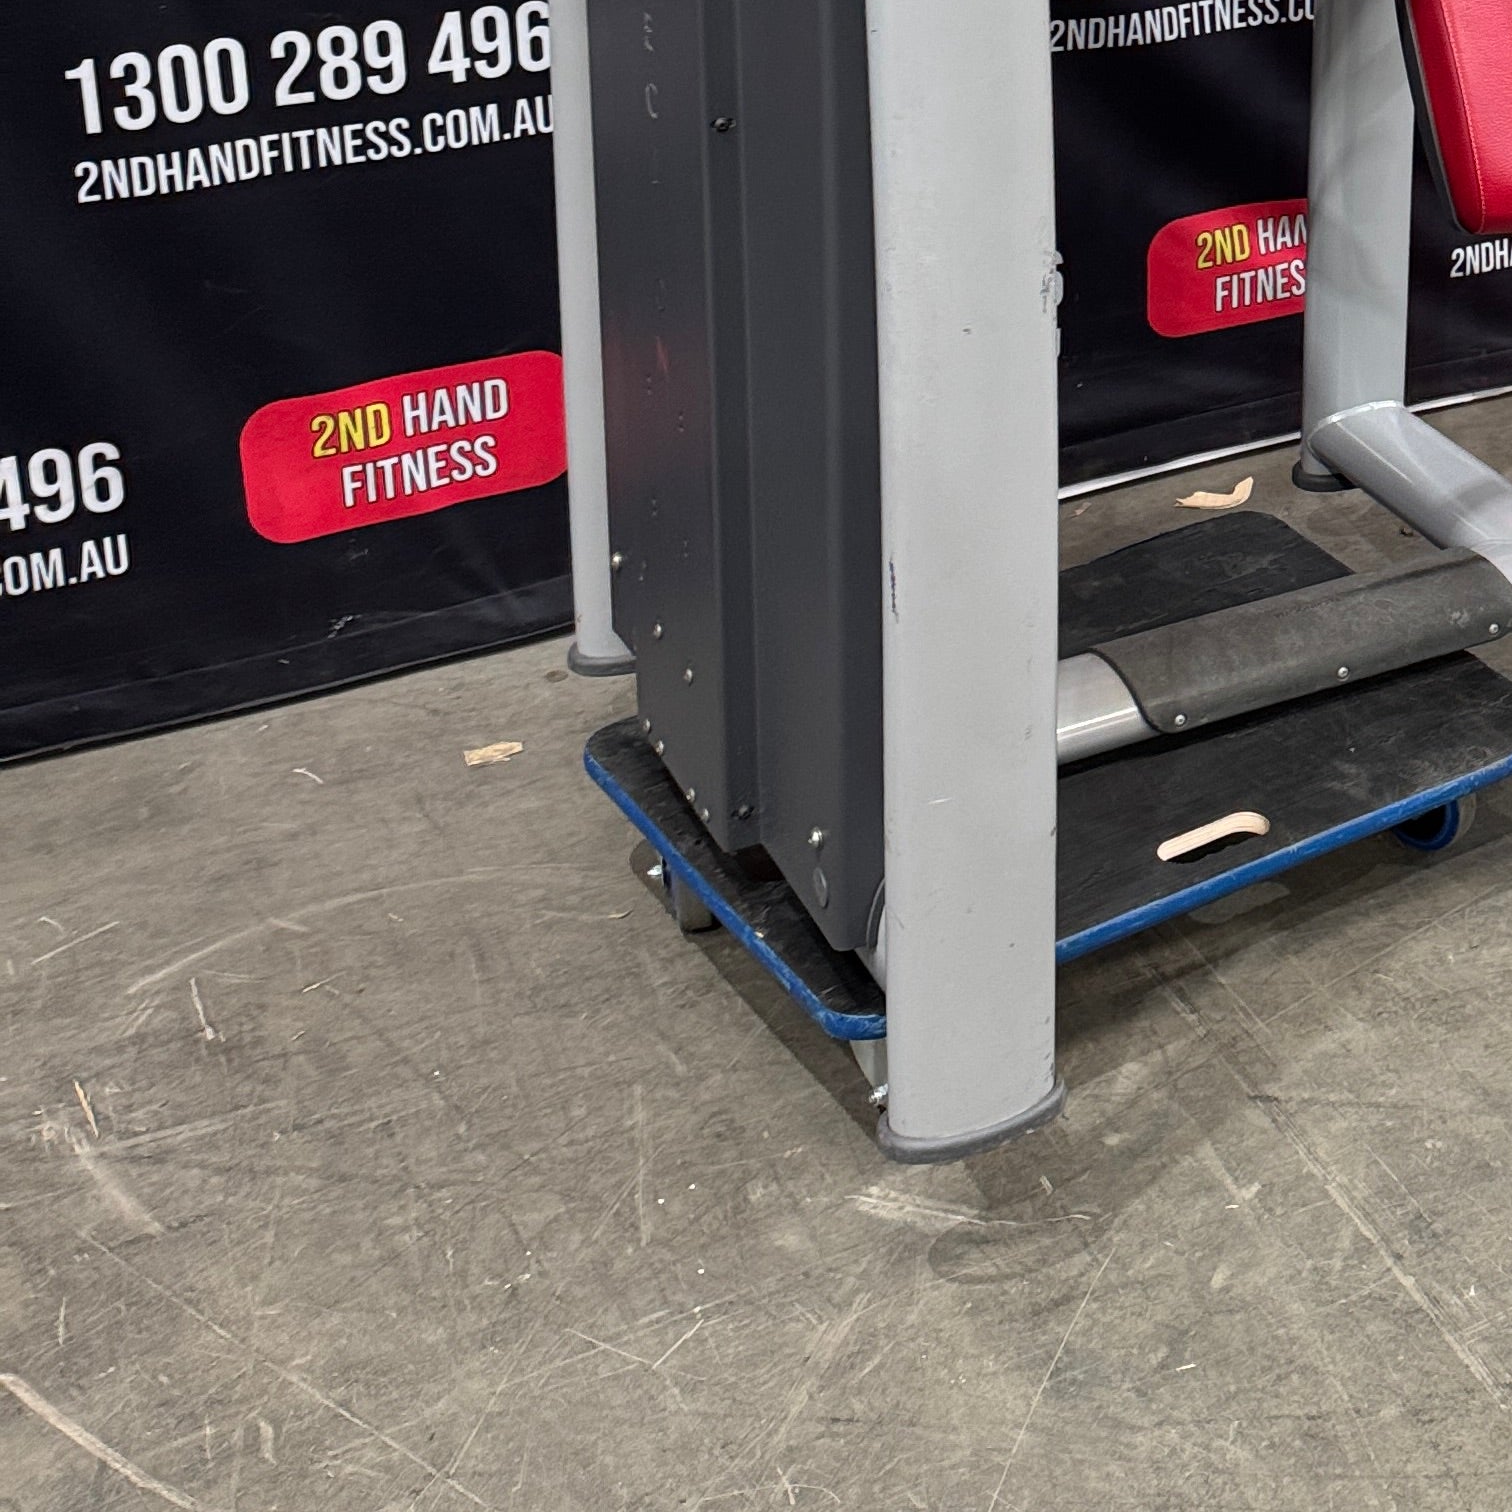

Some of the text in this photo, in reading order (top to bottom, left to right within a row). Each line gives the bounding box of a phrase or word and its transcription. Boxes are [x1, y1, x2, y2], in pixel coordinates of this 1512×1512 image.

[64, 0, 550, 134] 1300 289 496
[1197, 224, 1251, 269] 2ND
[311, 378, 508, 458] 2ND HAND
[341, 436, 498, 508] FITNESS
